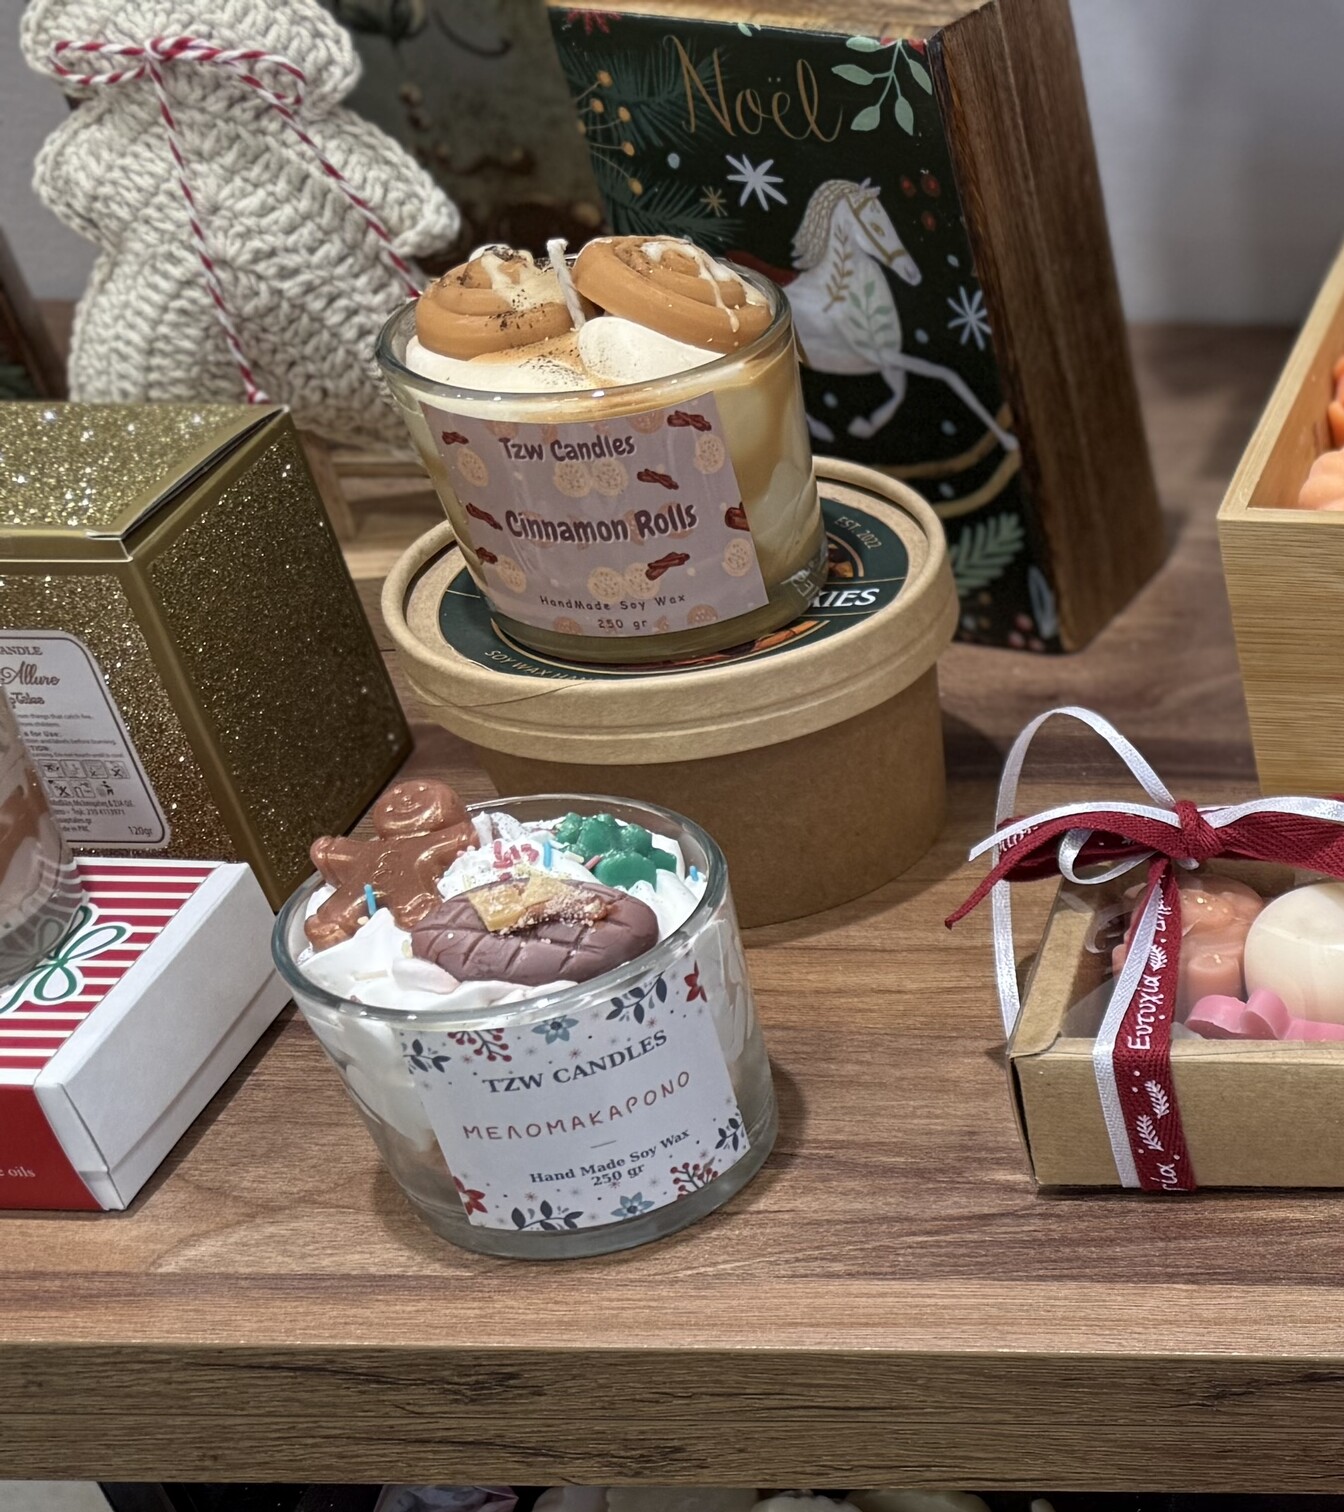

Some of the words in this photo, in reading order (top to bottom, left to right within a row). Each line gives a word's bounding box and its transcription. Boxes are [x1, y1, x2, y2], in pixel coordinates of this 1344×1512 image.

[663, 35, 843, 142] Noël
[499, 437, 544, 461] Tzw
[551, 435, 636, 462] Candles
[505, 509, 630, 543] Cinnamon
[634, 503, 698, 540] Rolls
[540, 595, 611, 611] HandMade
[620, 600, 646, 611] Soy
[654, 594, 686, 606] Wax
[597, 619, 624, 629] 250
[633, 619, 648, 631] gr
[484, 650, 517, 664] SOY
[482, 1073, 543, 1093] TZW
[552, 1030, 668, 1084] CANDLES
[463, 1071, 690, 1140] ΜΕΛΟΜΑΚΑΡΟΝΟ
[529, 1169, 576, 1184] Hand
[580, 1156, 626, 1177] Made
[629, 1145, 657, 1163] Soy
[659, 1129, 690, 1149] Wax
[8, 1166, 36, 1178] oils
[591, 1171, 622, 1187] 250
[627, 1164, 646, 1179] gr
